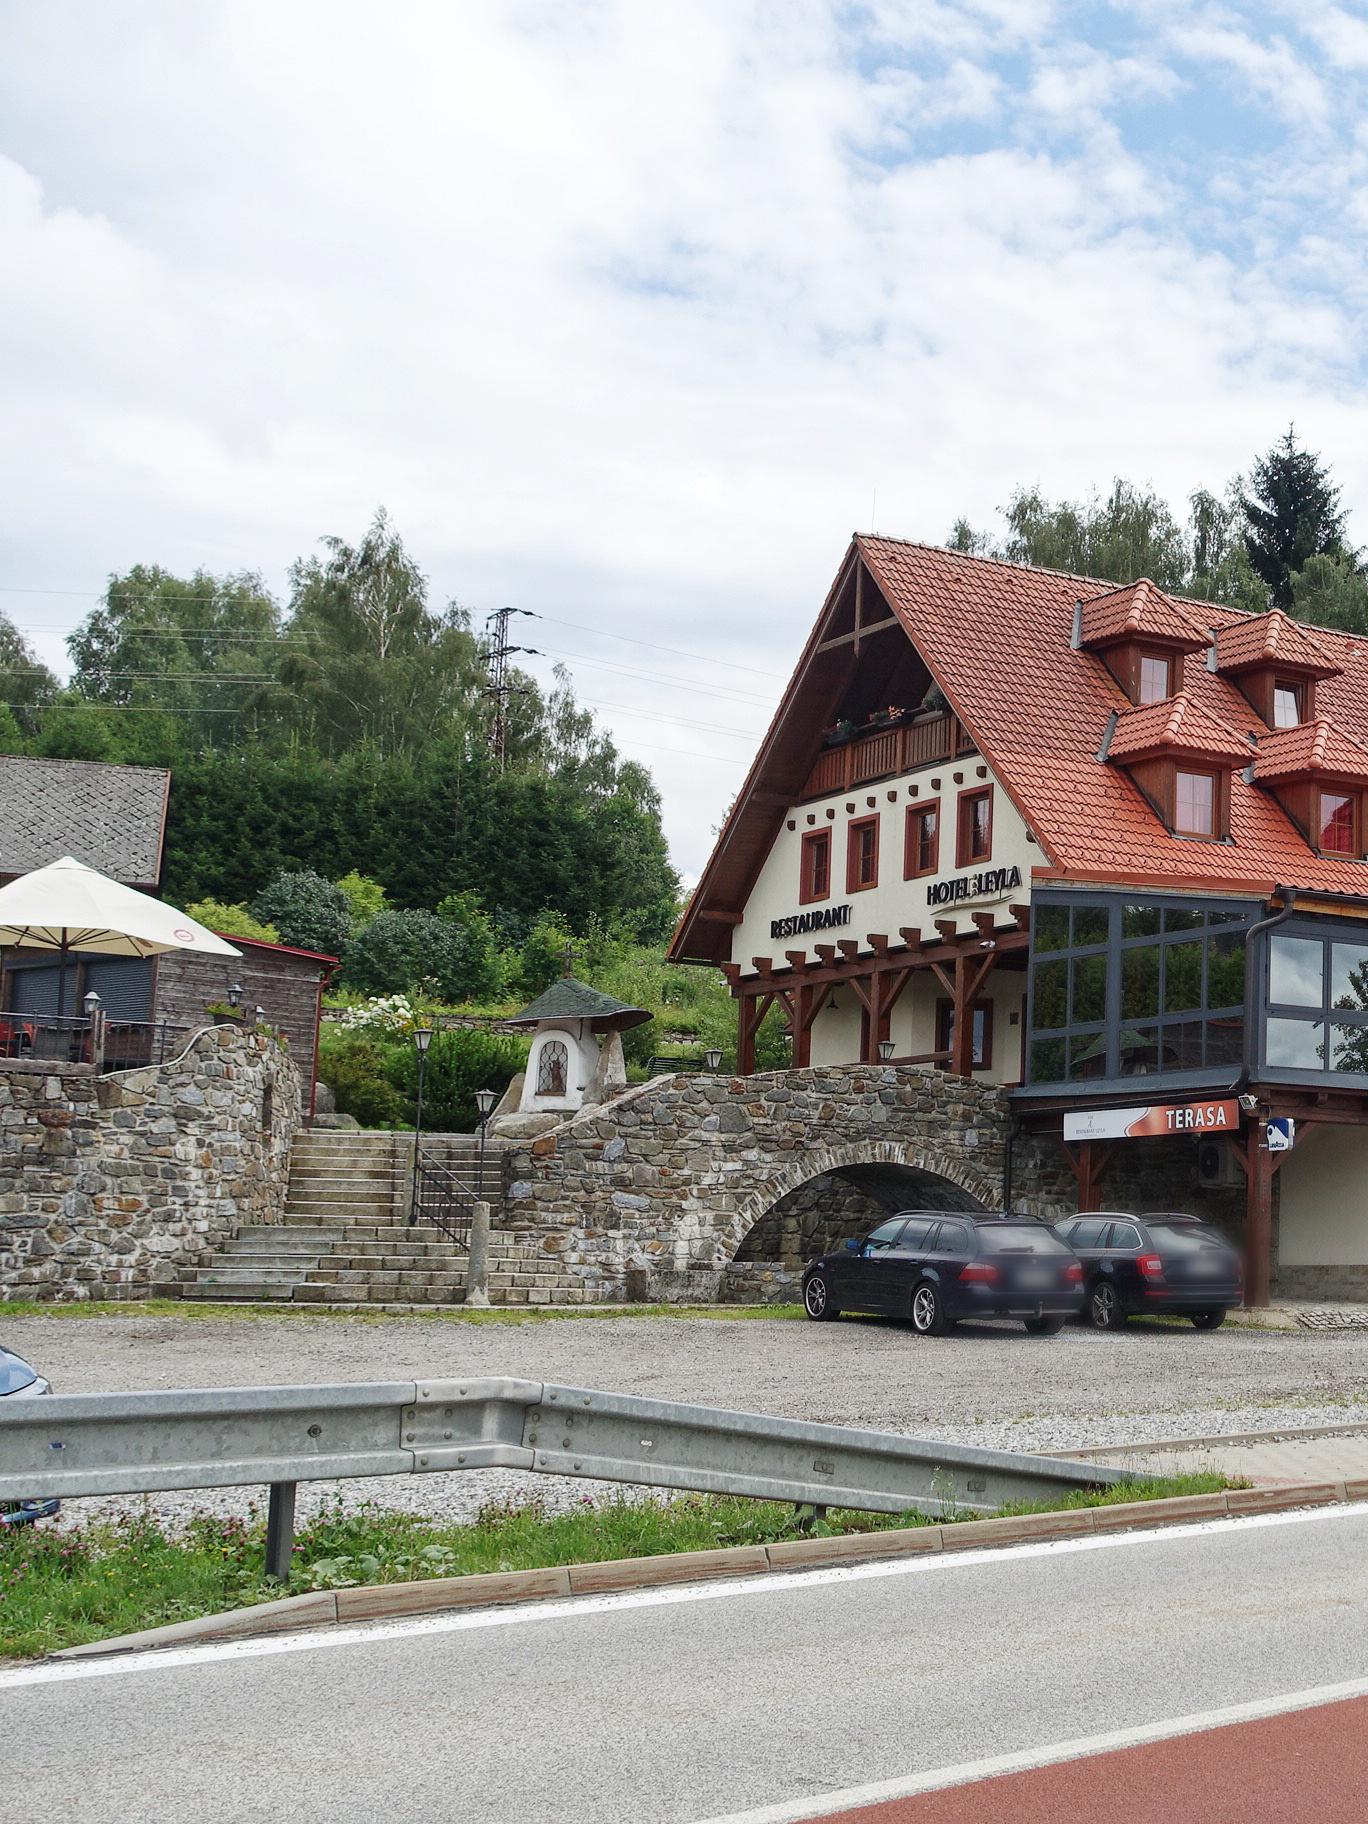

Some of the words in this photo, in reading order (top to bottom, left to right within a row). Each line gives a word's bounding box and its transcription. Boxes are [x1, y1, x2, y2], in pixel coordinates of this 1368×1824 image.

[926, 877, 970, 906] HOTEL
[976, 865, 1021, 893] LEYLA
[770, 904, 850, 939] RESTAURANT
[1165, 1105, 1227, 1129] TERASA
